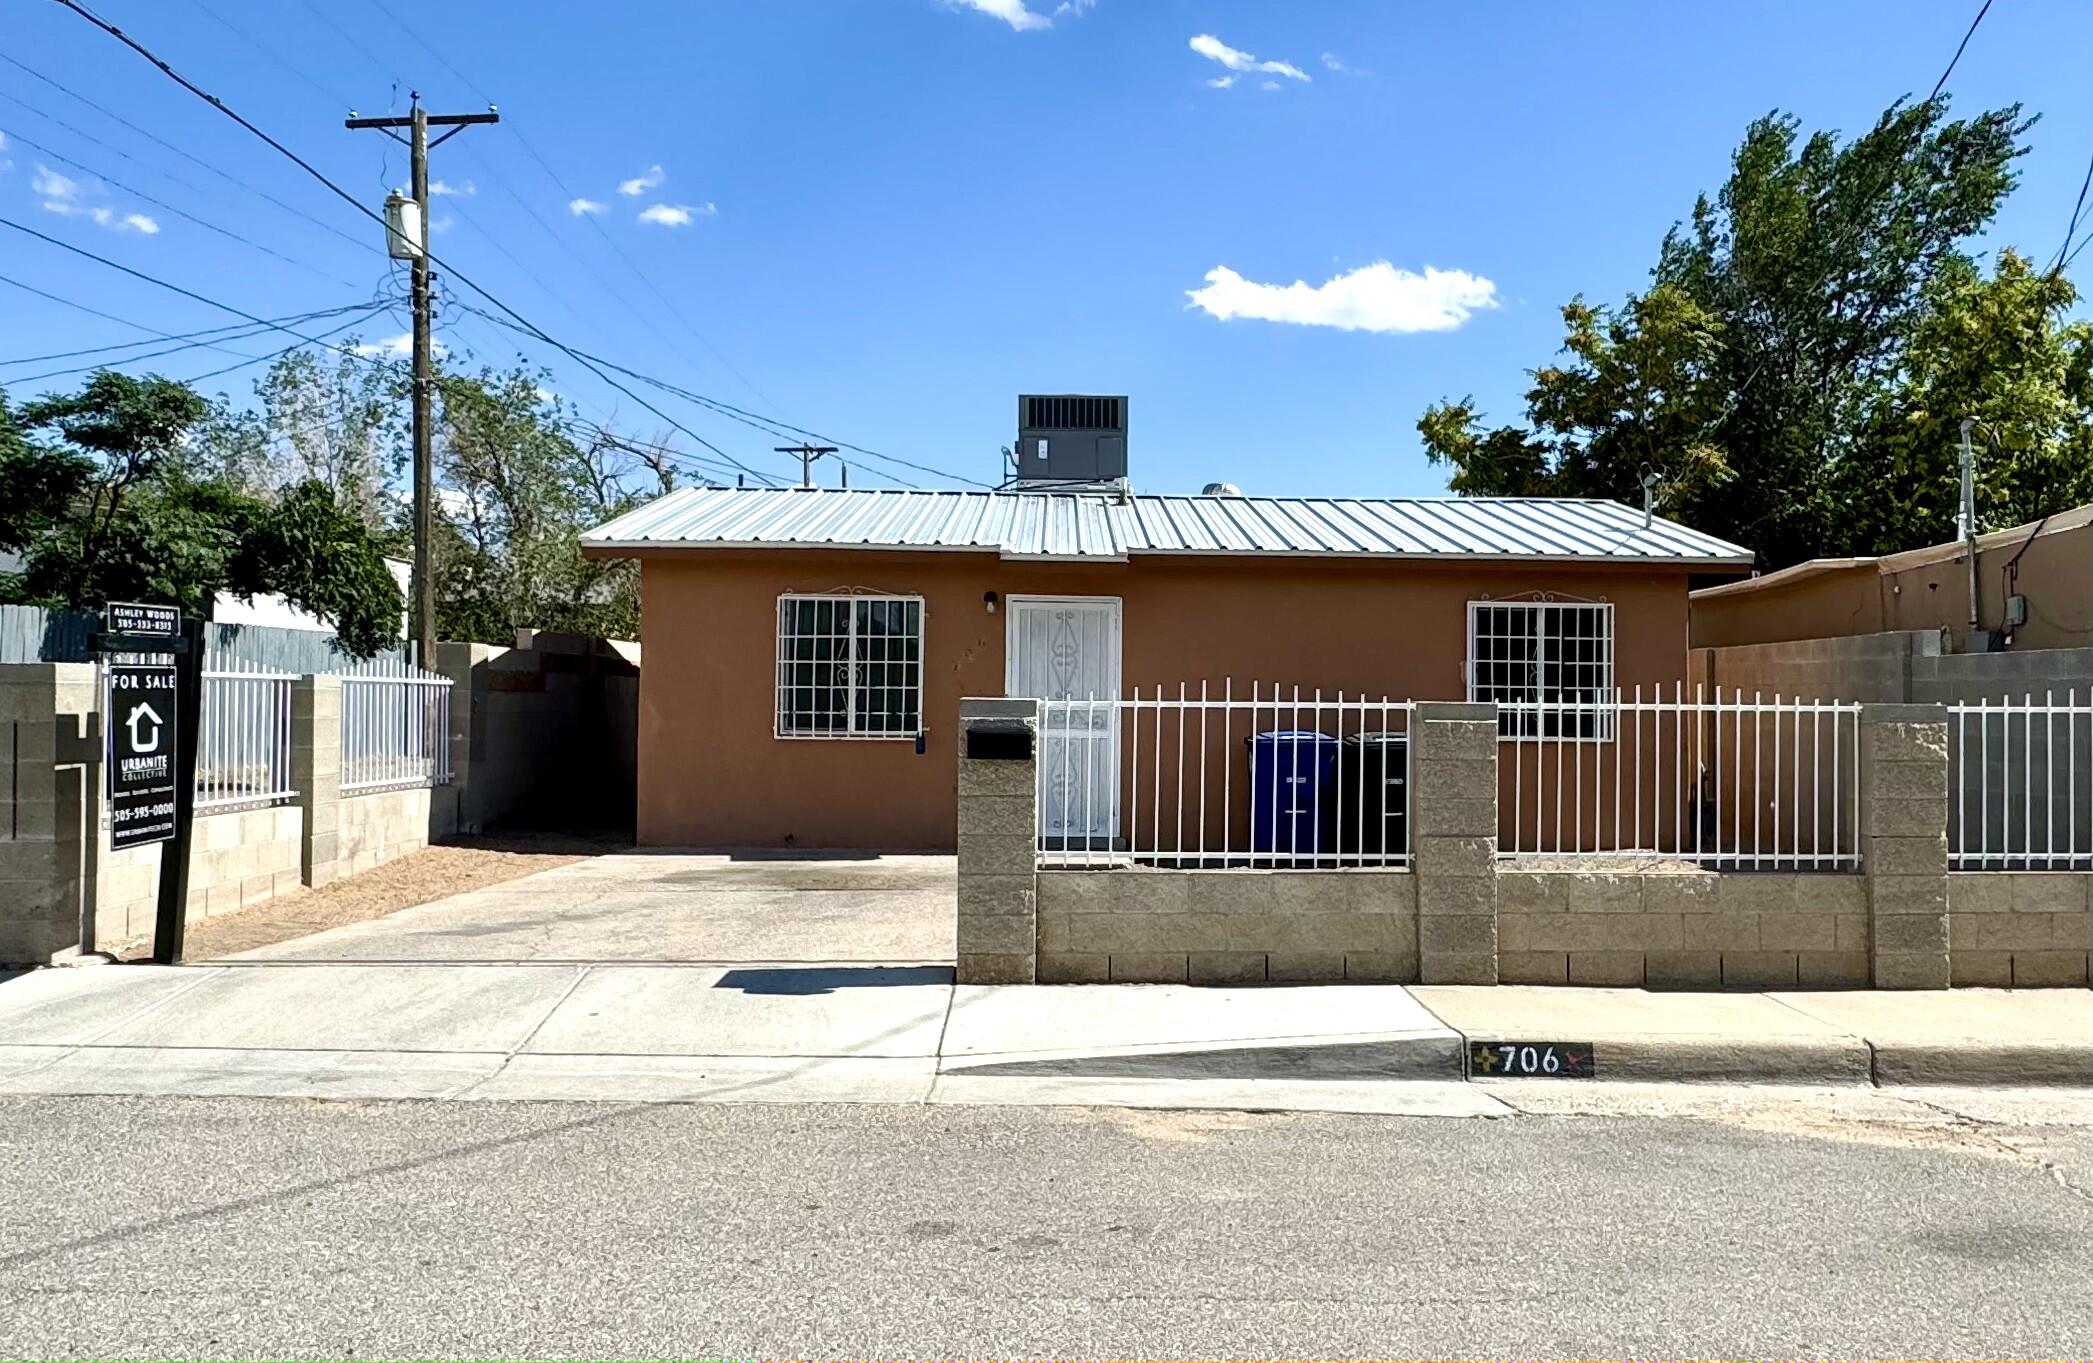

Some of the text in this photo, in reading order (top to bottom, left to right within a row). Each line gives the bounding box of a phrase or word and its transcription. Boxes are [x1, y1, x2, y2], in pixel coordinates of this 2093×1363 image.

[114, 607, 175, 620] ASHLEY WOODS
[112, 674, 176, 689] FOR SALE
[121, 755, 168, 772] URBANITE
[122, 769, 167, 782] COLLECTIVE
[1498, 1045, 1560, 1073] 706
